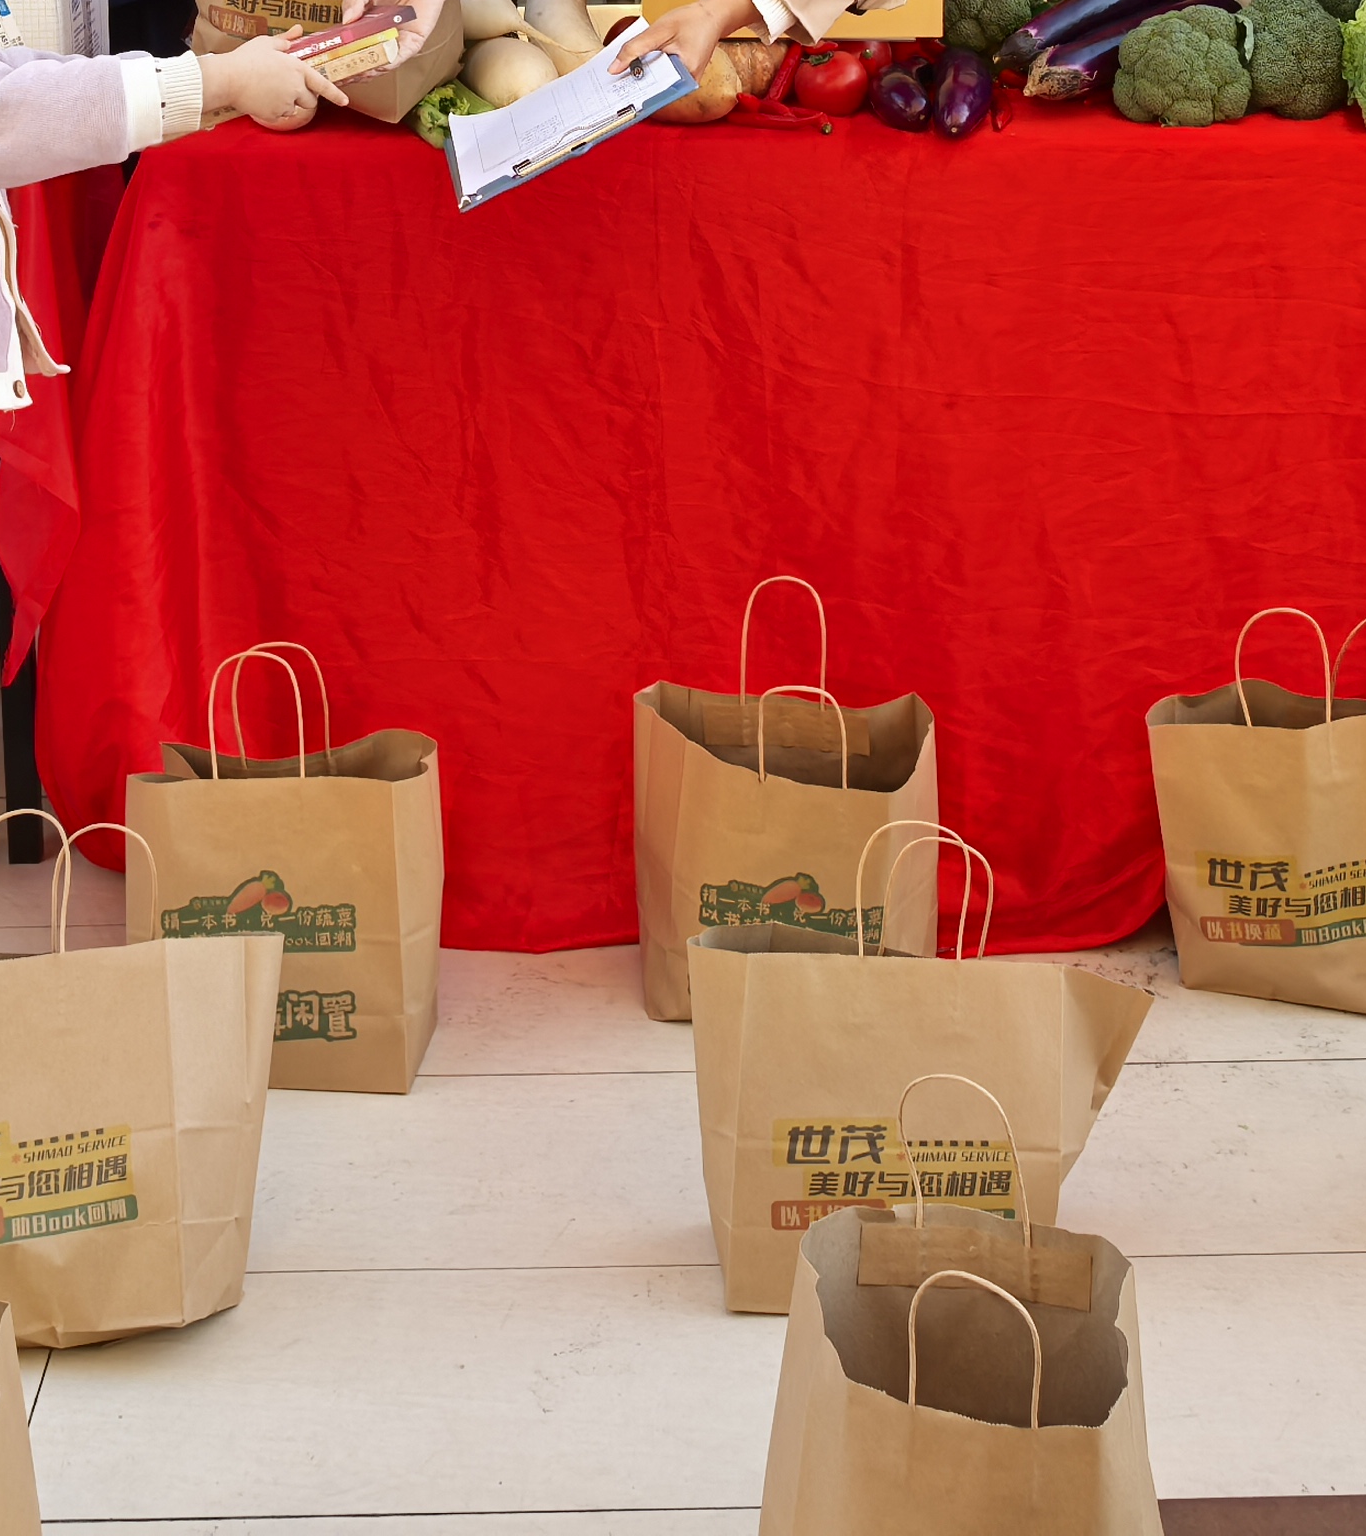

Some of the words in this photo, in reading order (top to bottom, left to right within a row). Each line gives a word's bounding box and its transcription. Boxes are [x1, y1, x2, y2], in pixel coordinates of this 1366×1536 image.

[1207, 857, 1289, 892] 世茂
[76, 1134, 127, 1155] SERVICE
[787, 1124, 888, 1164] 世茂
[961, 1150, 1012, 1163] SERVICE
[808, 1170, 1013, 1198] 美好与您相遇
